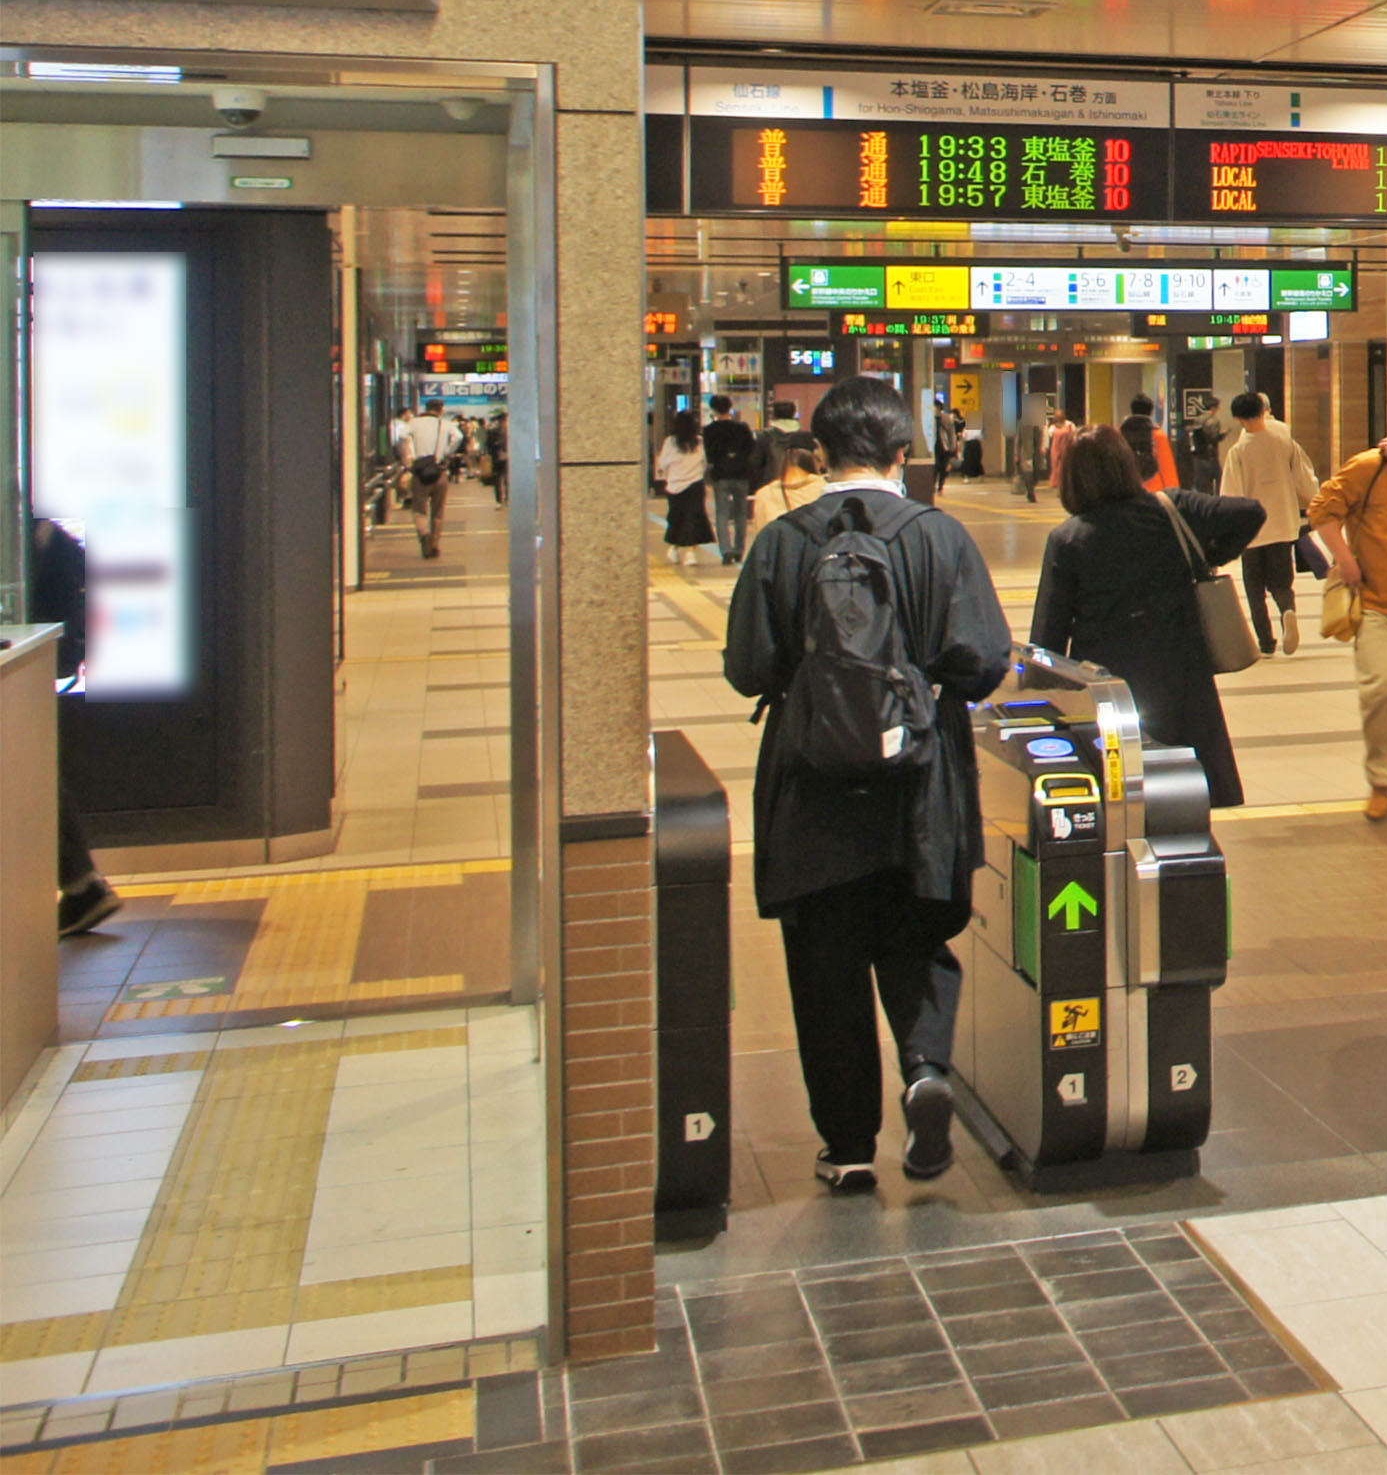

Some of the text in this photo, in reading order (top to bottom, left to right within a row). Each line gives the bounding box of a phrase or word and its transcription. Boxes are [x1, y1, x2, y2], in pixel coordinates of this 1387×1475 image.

[733, 83, 781, 99] 仙石線
[918, 135, 1131, 163] 19:33 東塩釜 10
[1210, 143, 1257, 165] RAPID
[918, 160, 1131, 186] 19:48 10
[1211, 166, 1257, 188] LOCAL
[918, 184, 1131, 211] 19:57 東塩釜 10
[1211, 188, 1257, 211] LOCAL
[1068, 1079, 1077, 1094] 1
[1176, 1069, 1188, 1085] 2
[692, 1116, 703, 1134] 1
